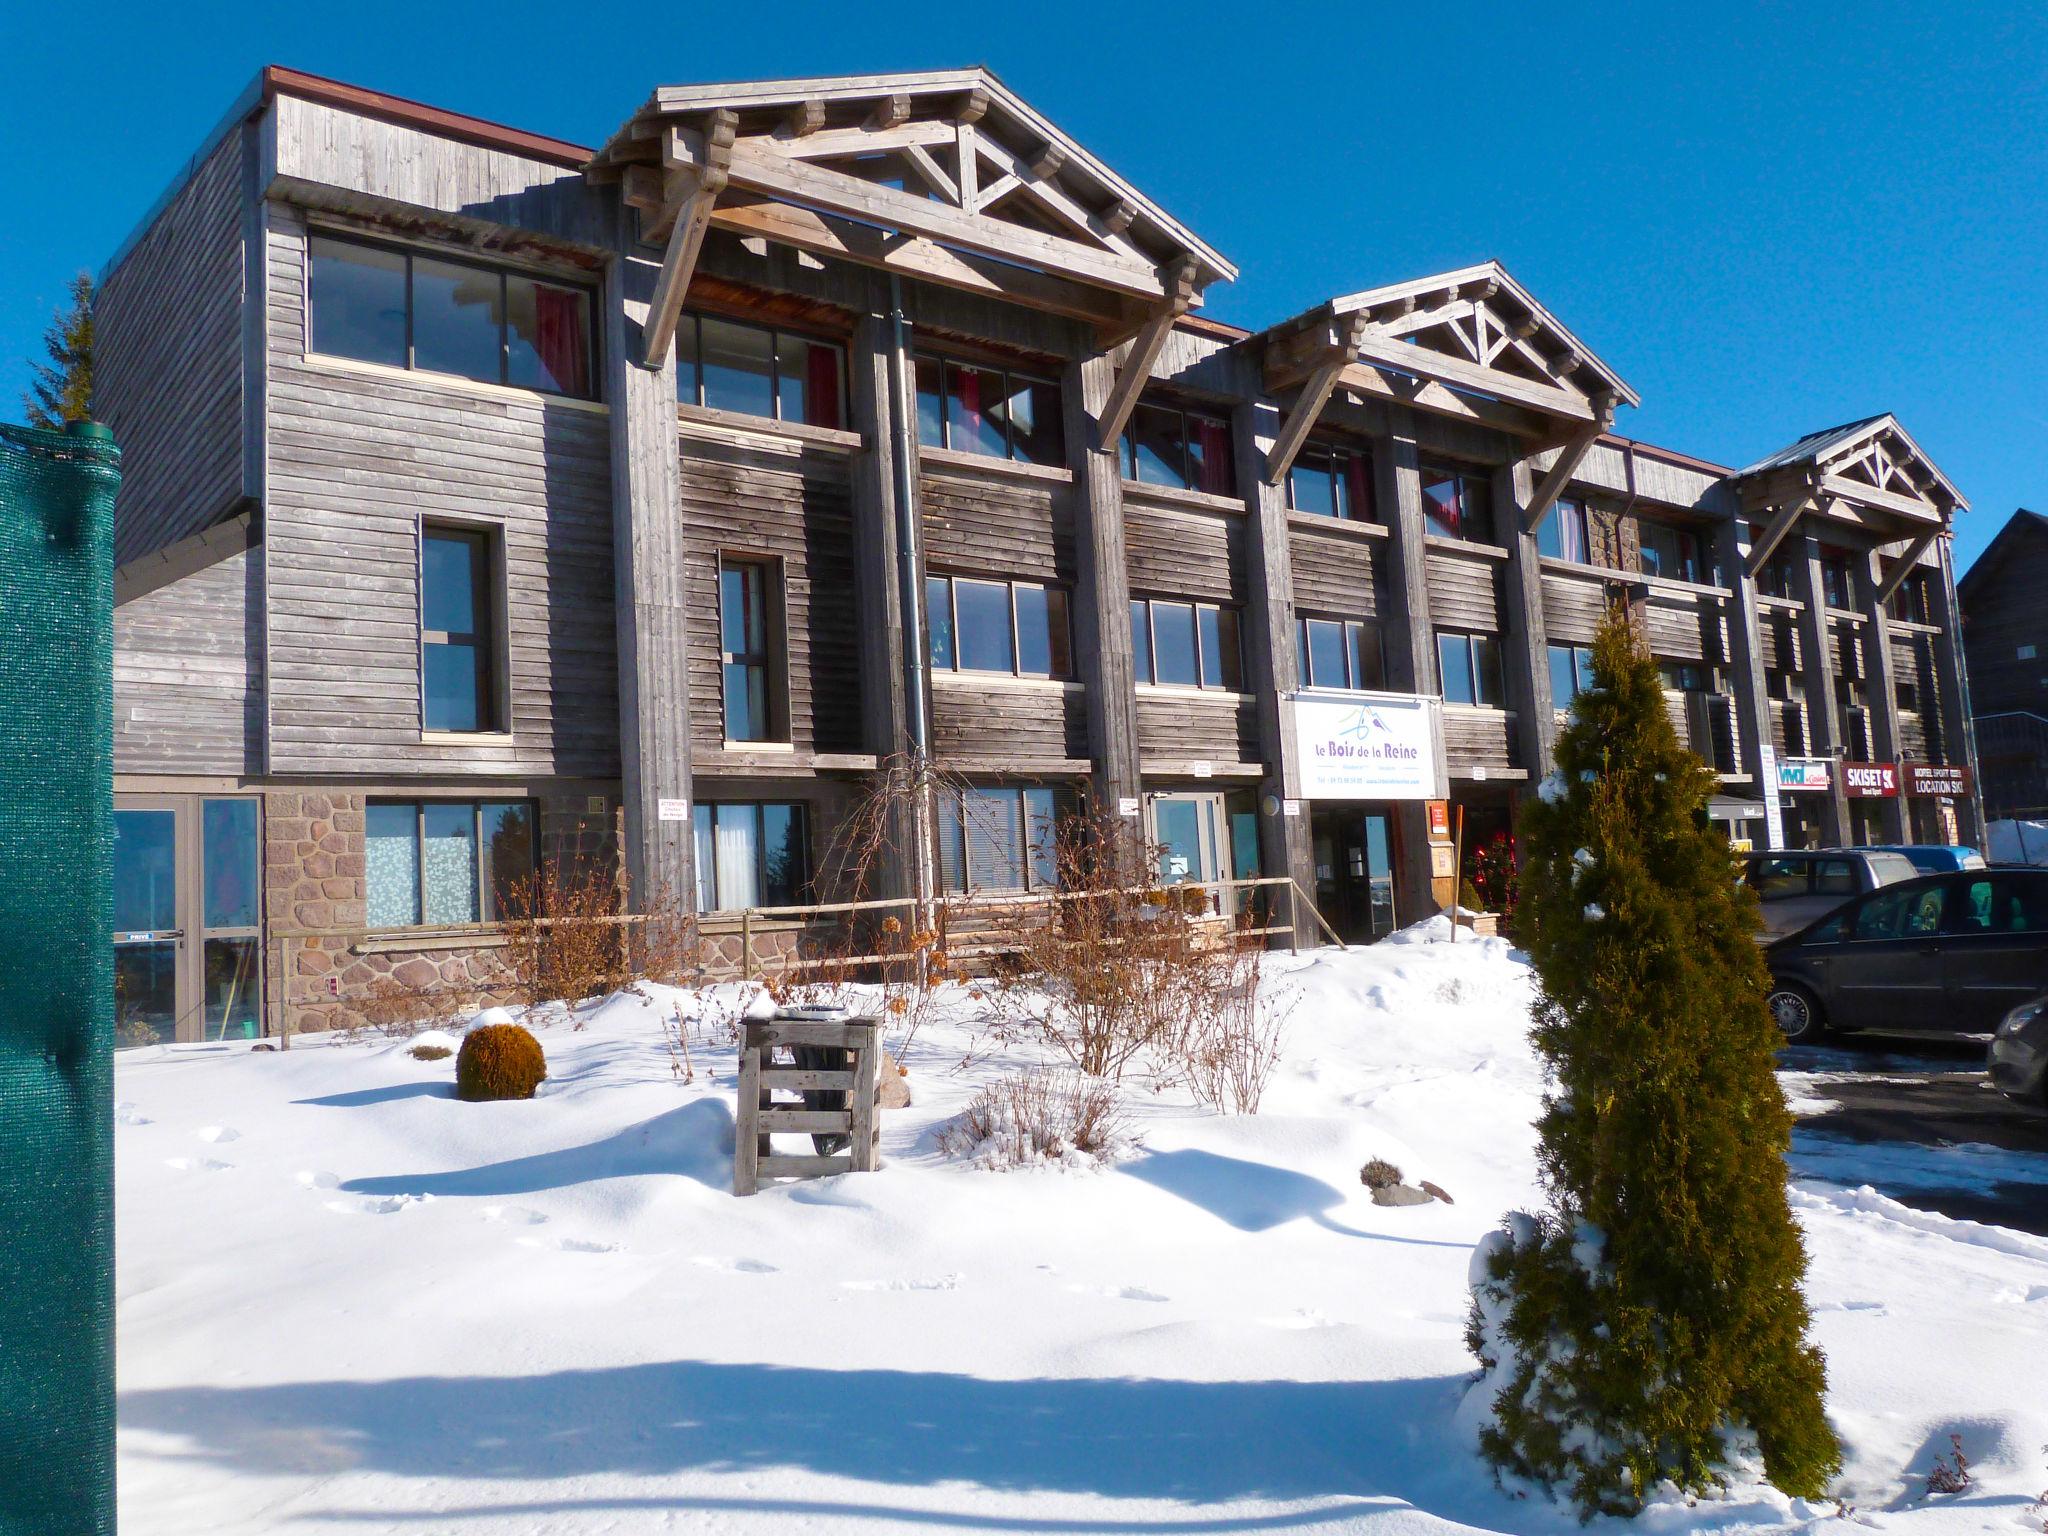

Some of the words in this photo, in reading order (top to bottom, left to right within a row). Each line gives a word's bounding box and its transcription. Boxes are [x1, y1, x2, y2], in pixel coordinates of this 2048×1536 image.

[1328, 741, 1354, 757] Bois
[1357, 746, 1369, 758] de
[1372, 746, 1381, 758] la
[1384, 743, 1418, 759] Reine
[1847, 768, 1882, 787] SKISET
[1915, 779, 1951, 793] LOCATION
